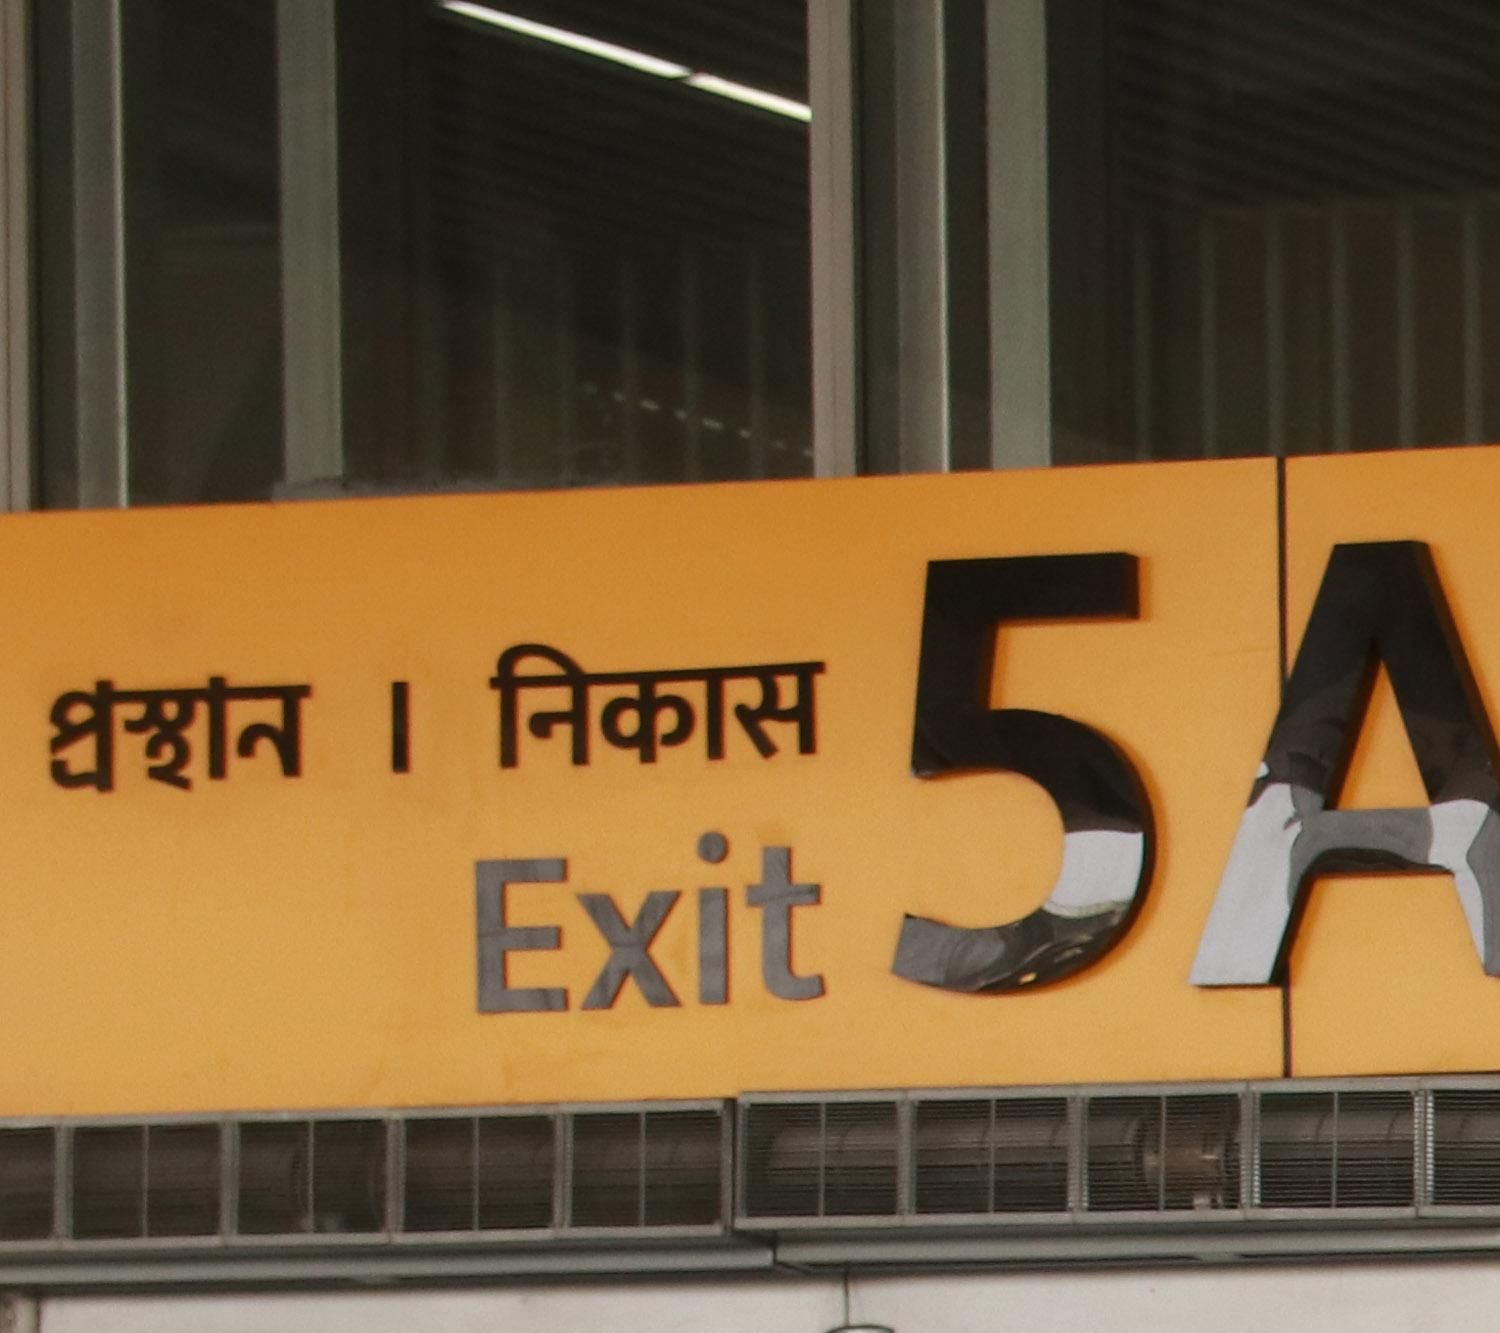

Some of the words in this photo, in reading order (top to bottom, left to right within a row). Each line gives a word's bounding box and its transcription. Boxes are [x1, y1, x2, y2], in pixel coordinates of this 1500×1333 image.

[49, 676, 312, 793] প্রস্থান
[489, 643, 826, 768] निकास
[475, 832, 827, 1014] Exit
